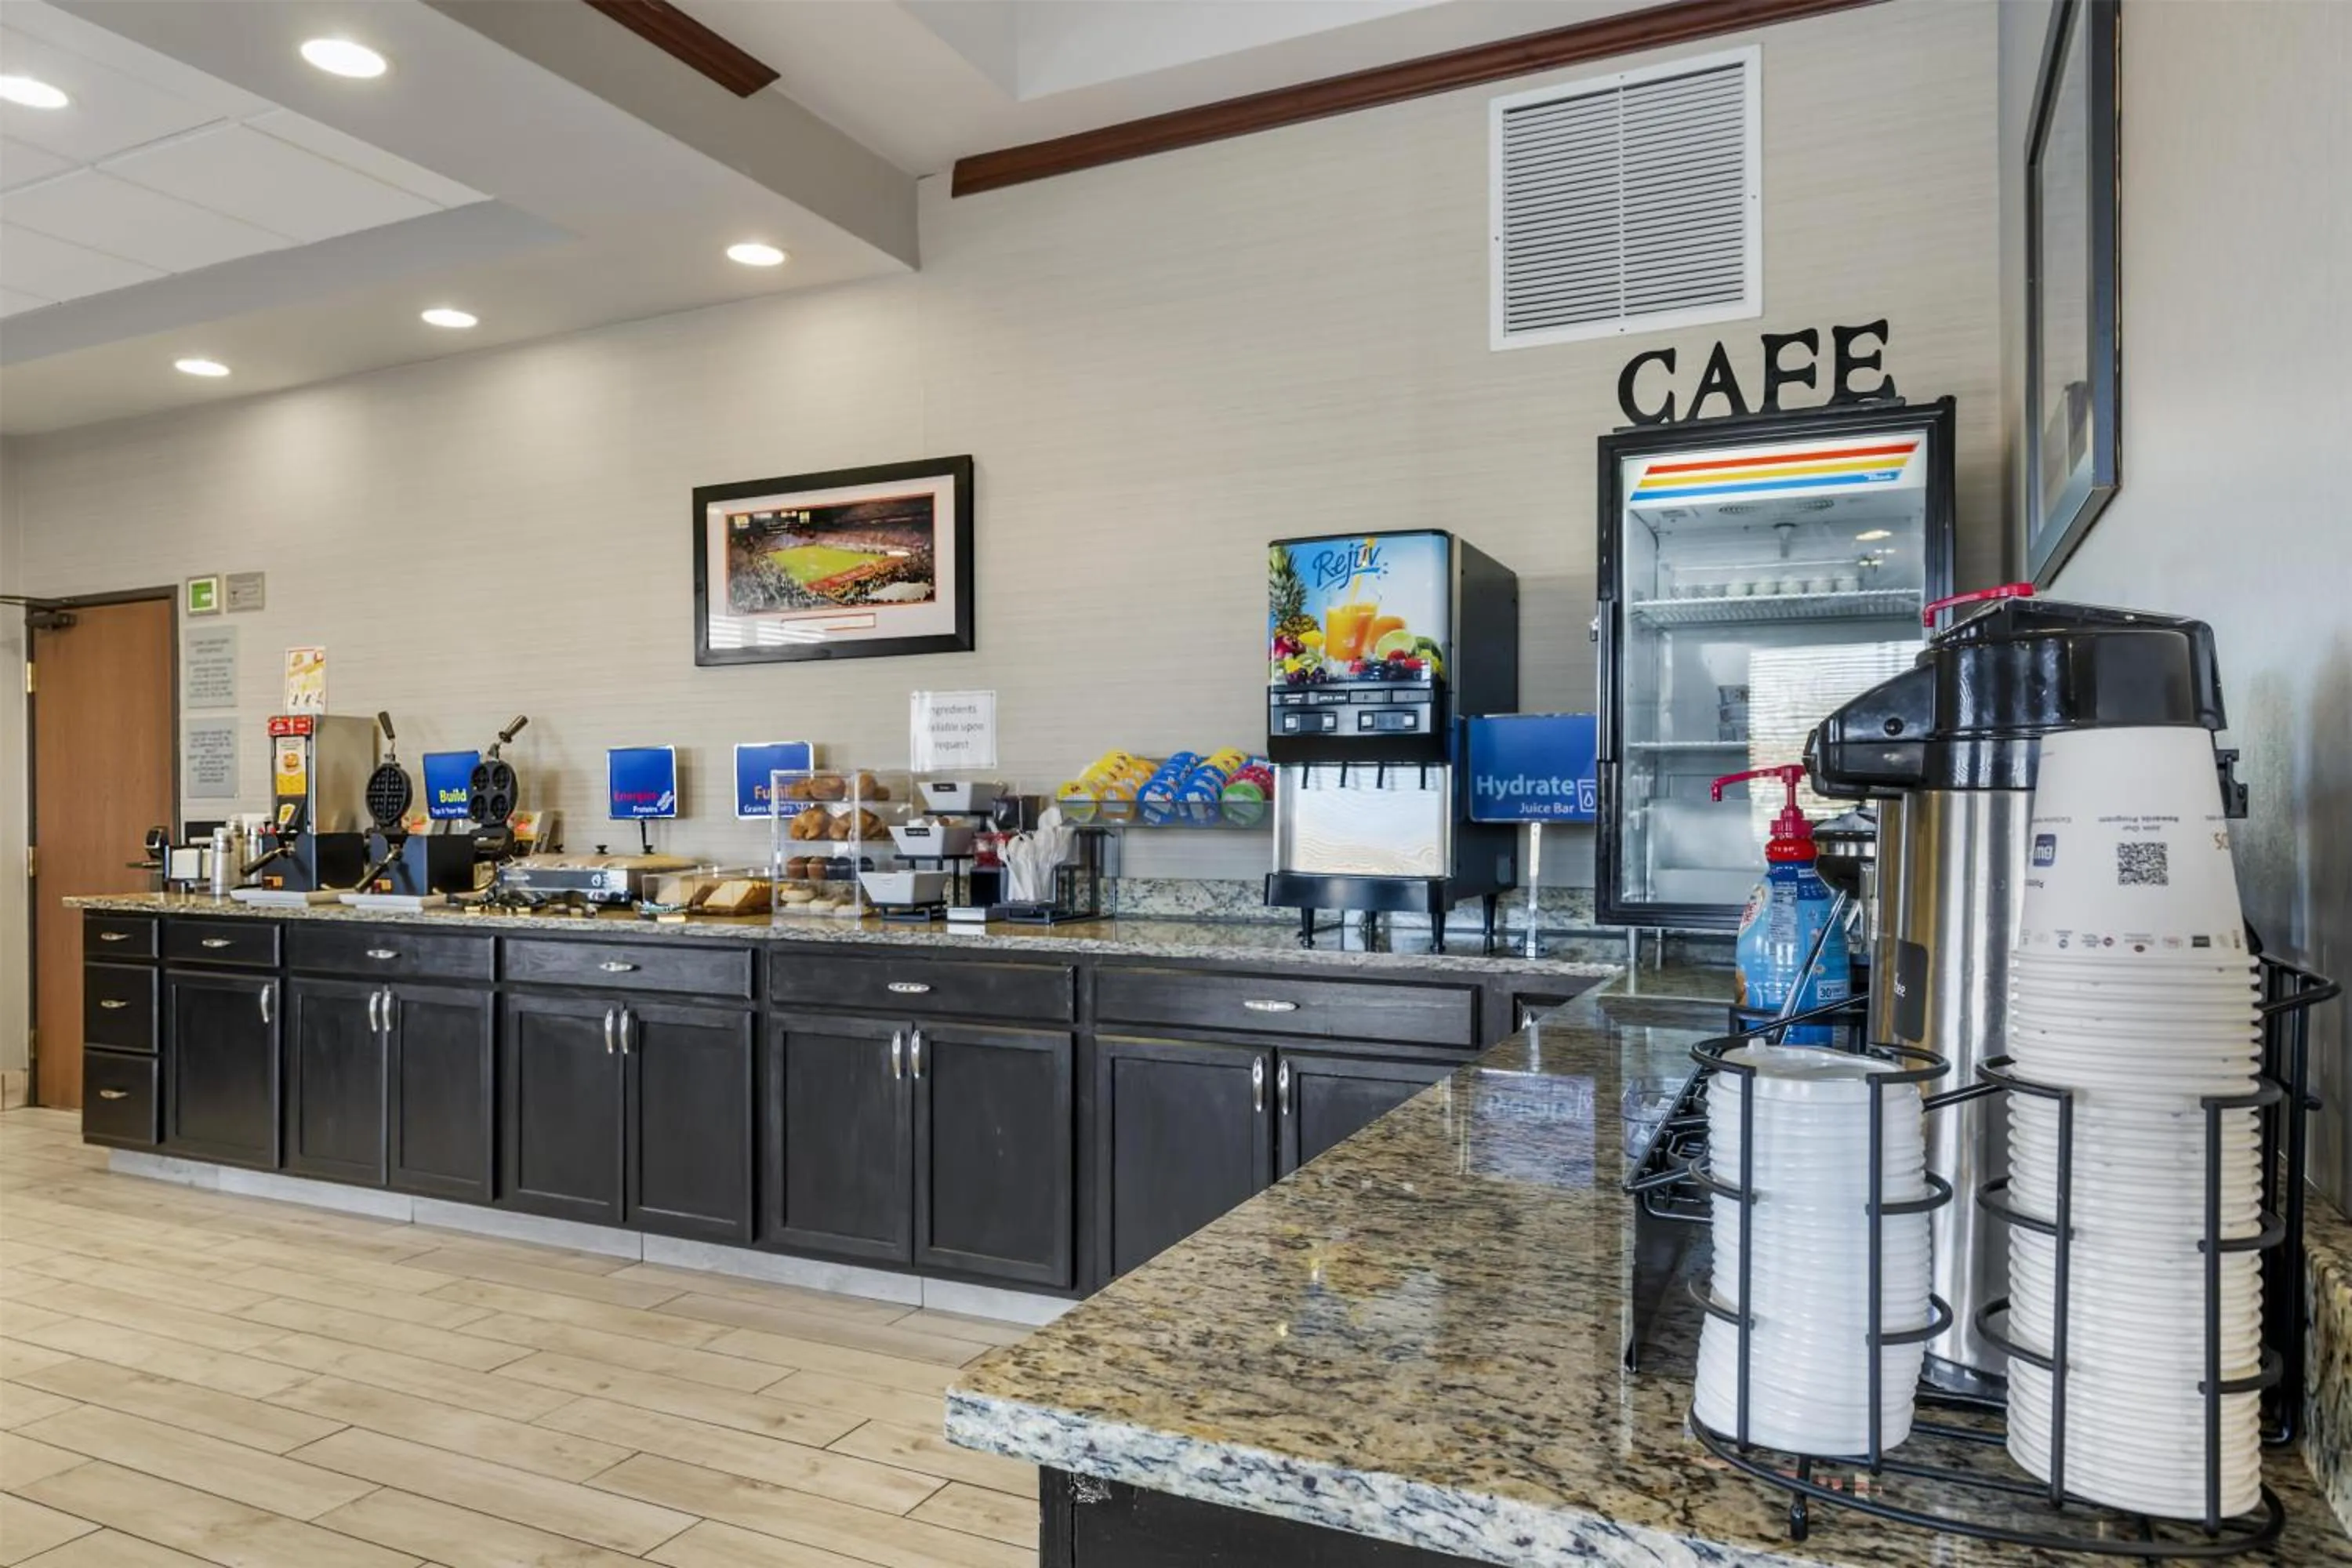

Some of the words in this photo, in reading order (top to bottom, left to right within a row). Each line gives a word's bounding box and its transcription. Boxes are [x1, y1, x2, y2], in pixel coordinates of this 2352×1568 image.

[1617, 319, 1896, 426] CAFE
[1476, 774, 1575, 800] Hydrate
[440, 788, 466, 803] Build
[1519, 803, 1550, 814] Juice
[1553, 803, 1574, 813] Bar
[1820, 987, 1832, 998] 30
